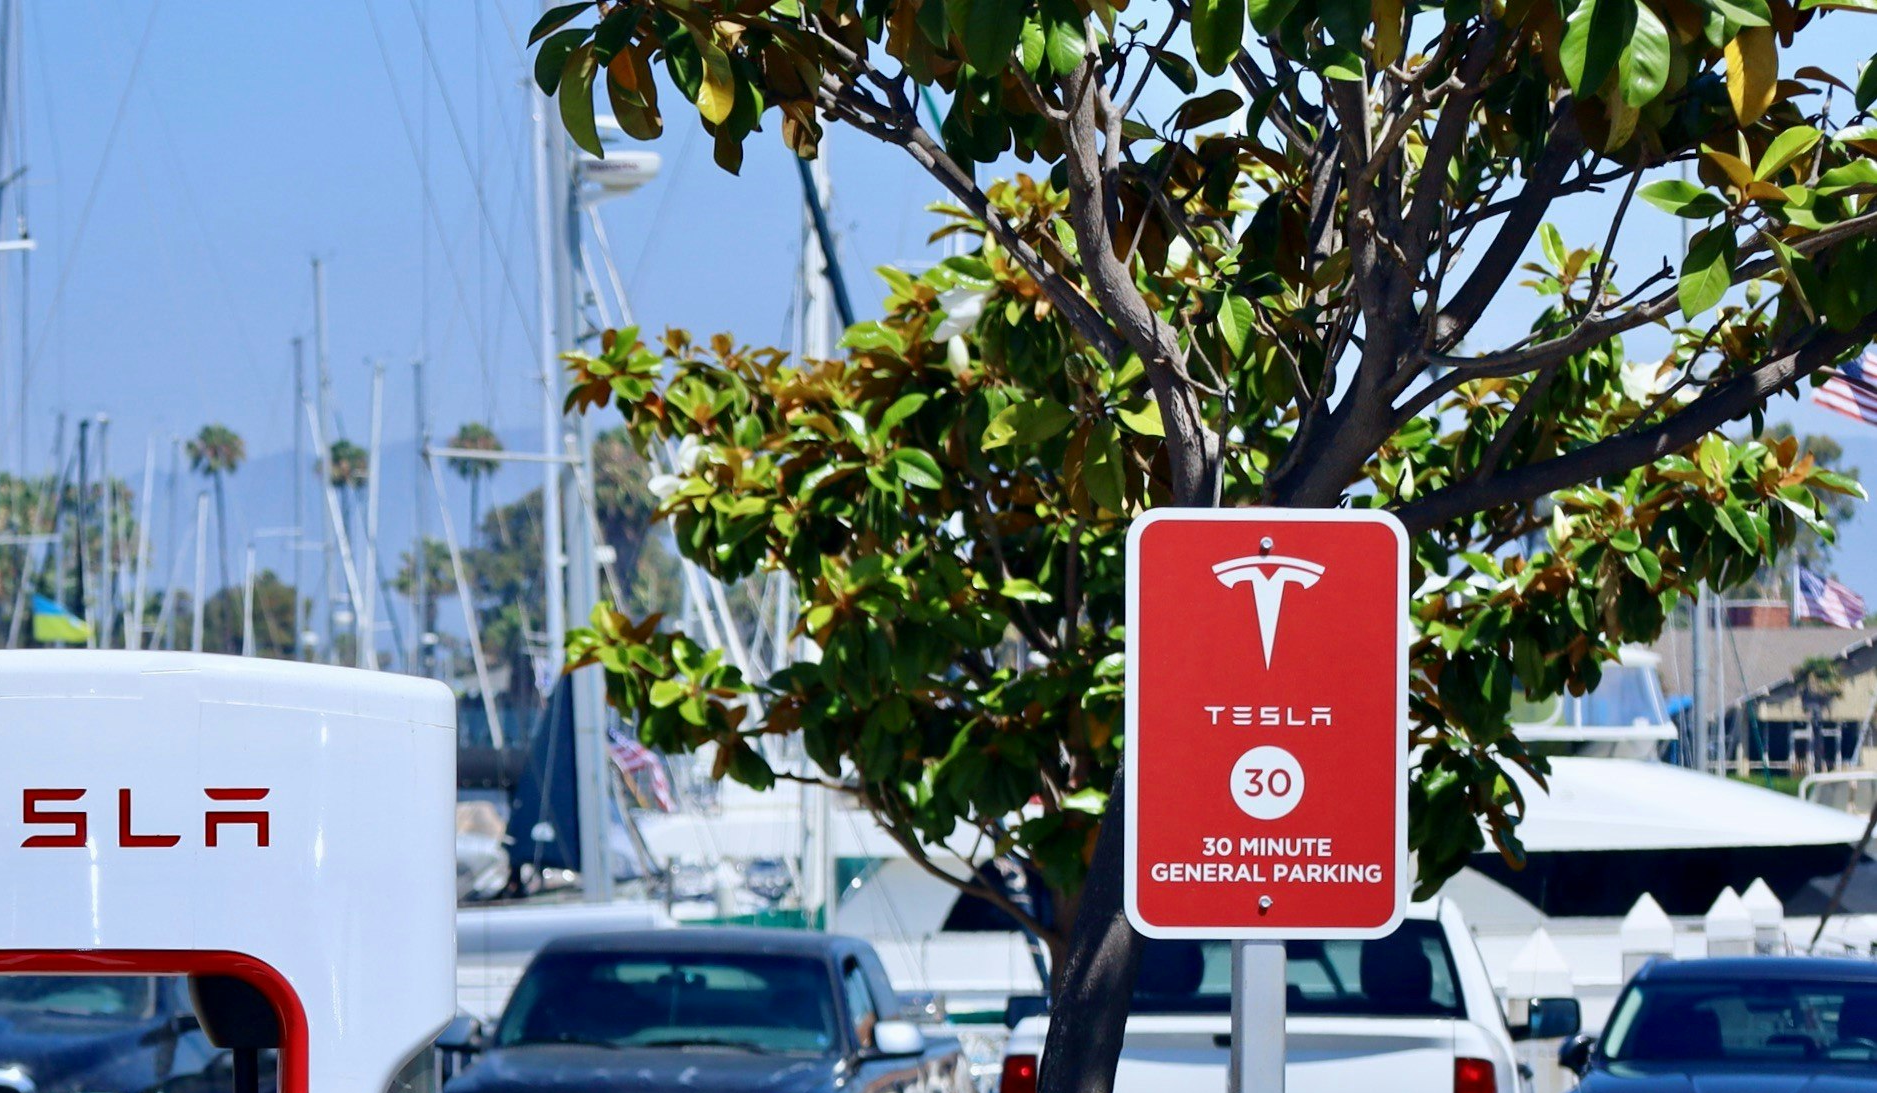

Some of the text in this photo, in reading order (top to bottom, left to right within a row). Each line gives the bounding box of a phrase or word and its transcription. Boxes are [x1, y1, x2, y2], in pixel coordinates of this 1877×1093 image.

[1204, 706, 1332, 726] TESLA
[1244, 768, 1292, 797] 30
[1202, 837, 1332, 857] 30 MINUTE
[1151, 862, 1382, 884] GENERAL PARKING
